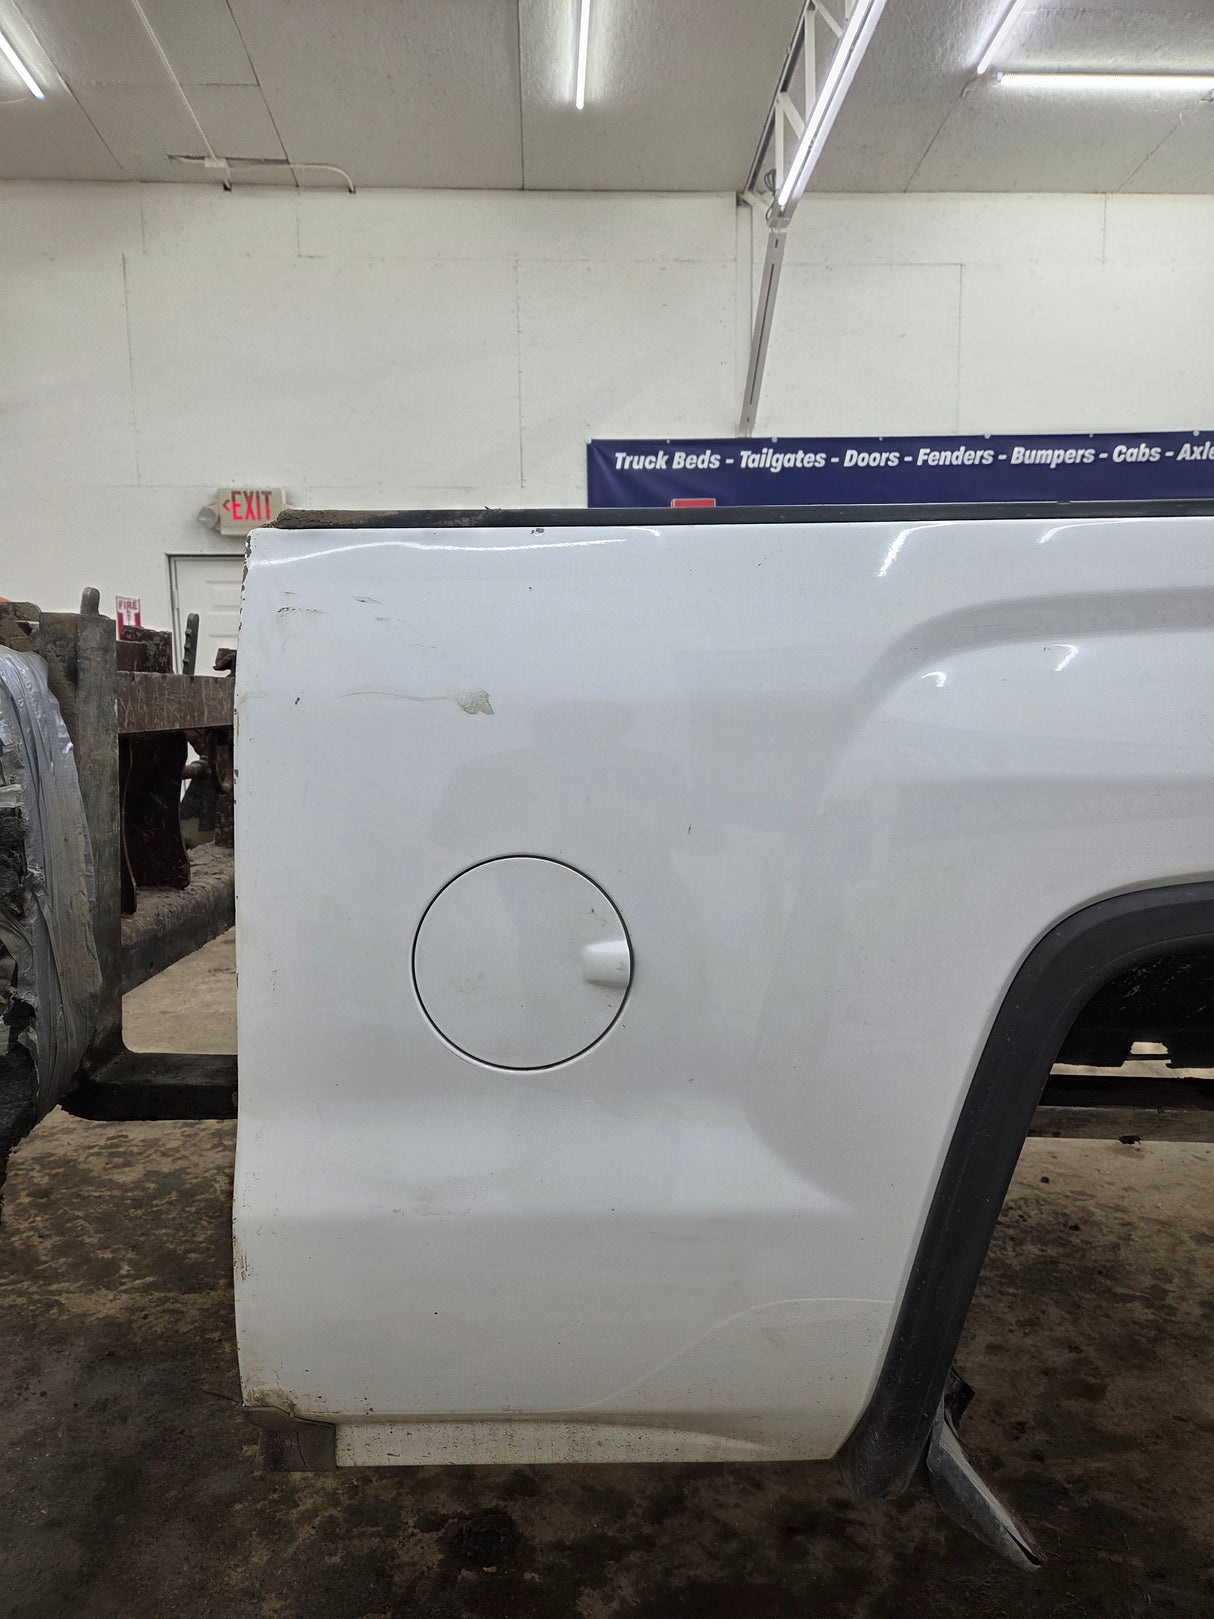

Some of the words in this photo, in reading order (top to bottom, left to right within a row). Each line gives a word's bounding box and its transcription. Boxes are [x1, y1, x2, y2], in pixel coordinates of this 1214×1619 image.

[615, 451, 667, 469] Truck
[672, 450, 720, 469] Beds
[740, 448, 827, 472] Tailgates
[844, 450, 900, 467] Doors
[917, 446, 994, 466] Fenders
[1011, 446, 1095, 468] Bumpers
[1113, 443, 1161, 462] Cabs
[231, 490, 272, 521] EXIT
[118, 599, 138, 610] FIRE
